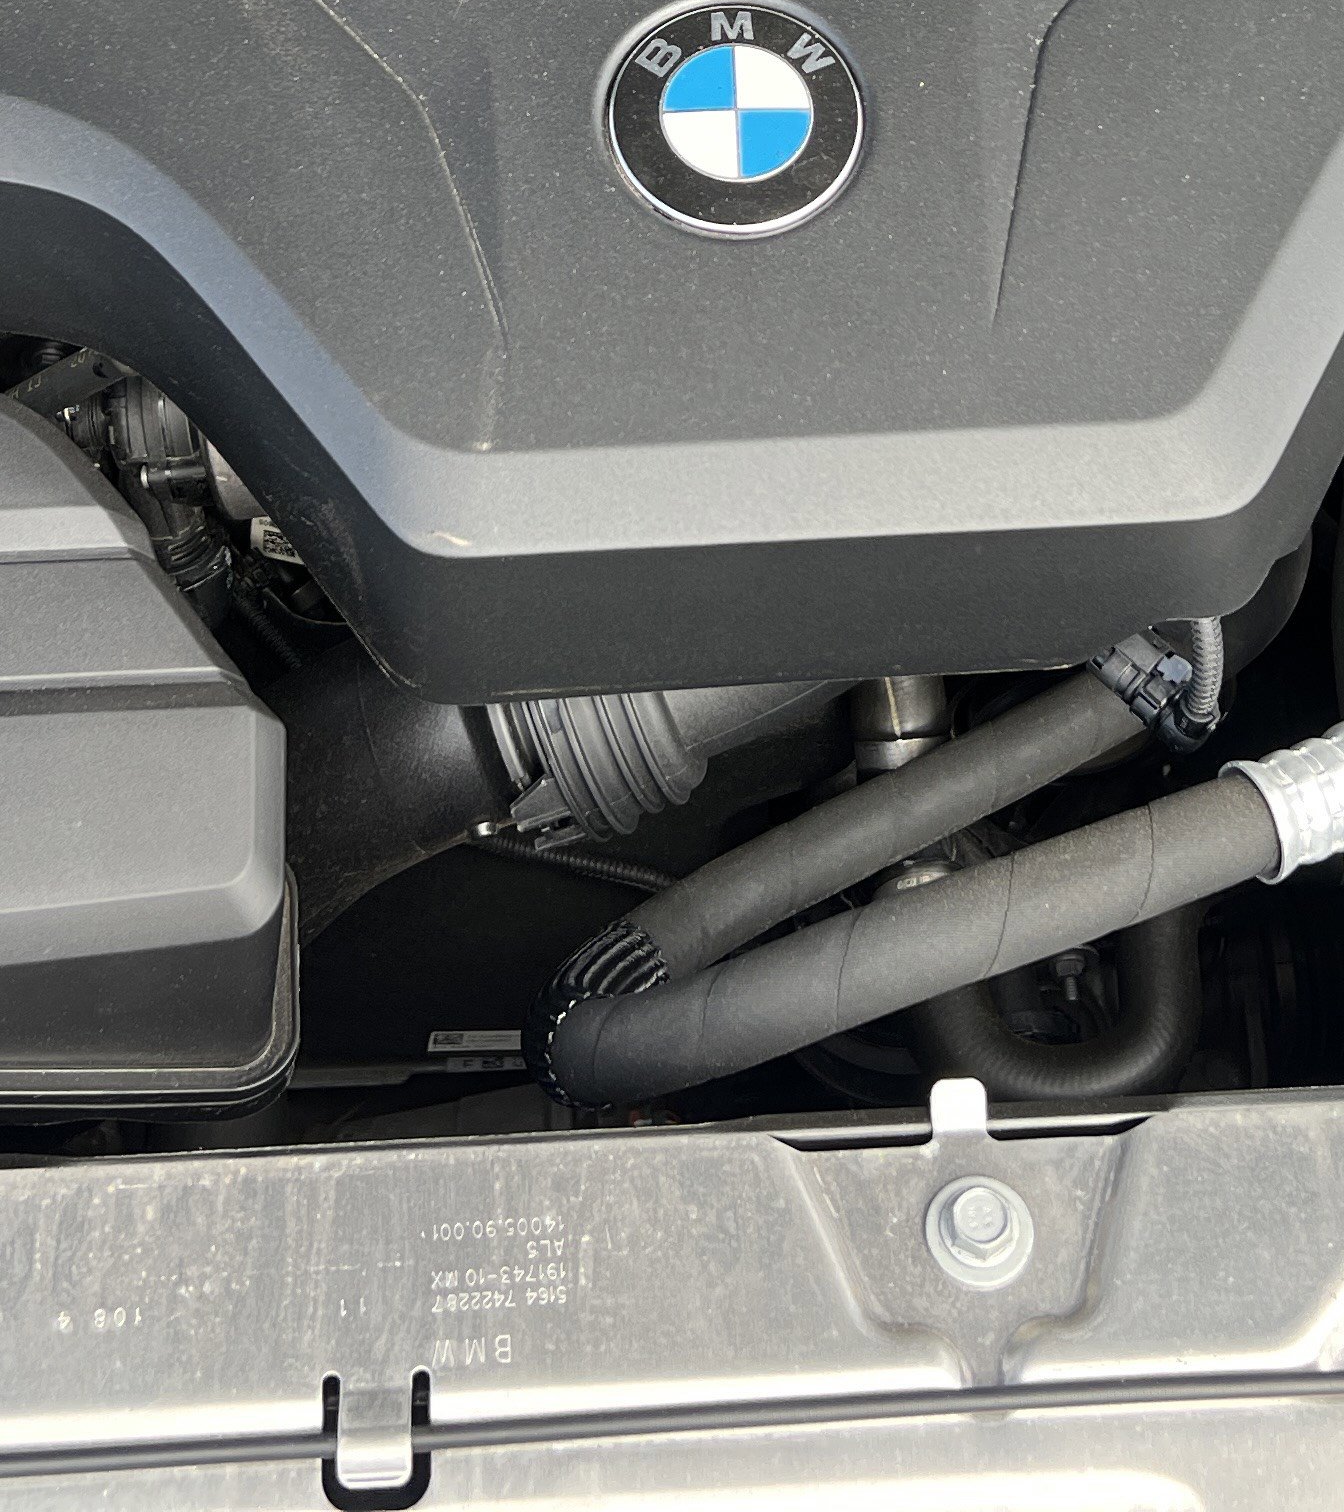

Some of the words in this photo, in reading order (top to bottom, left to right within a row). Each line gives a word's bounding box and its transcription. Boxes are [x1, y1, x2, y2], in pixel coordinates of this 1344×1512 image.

[635, 11, 835, 78] BMW
[432, 1290, 516, 1313] 7422287
[526, 1285, 567, 1305] 5164
